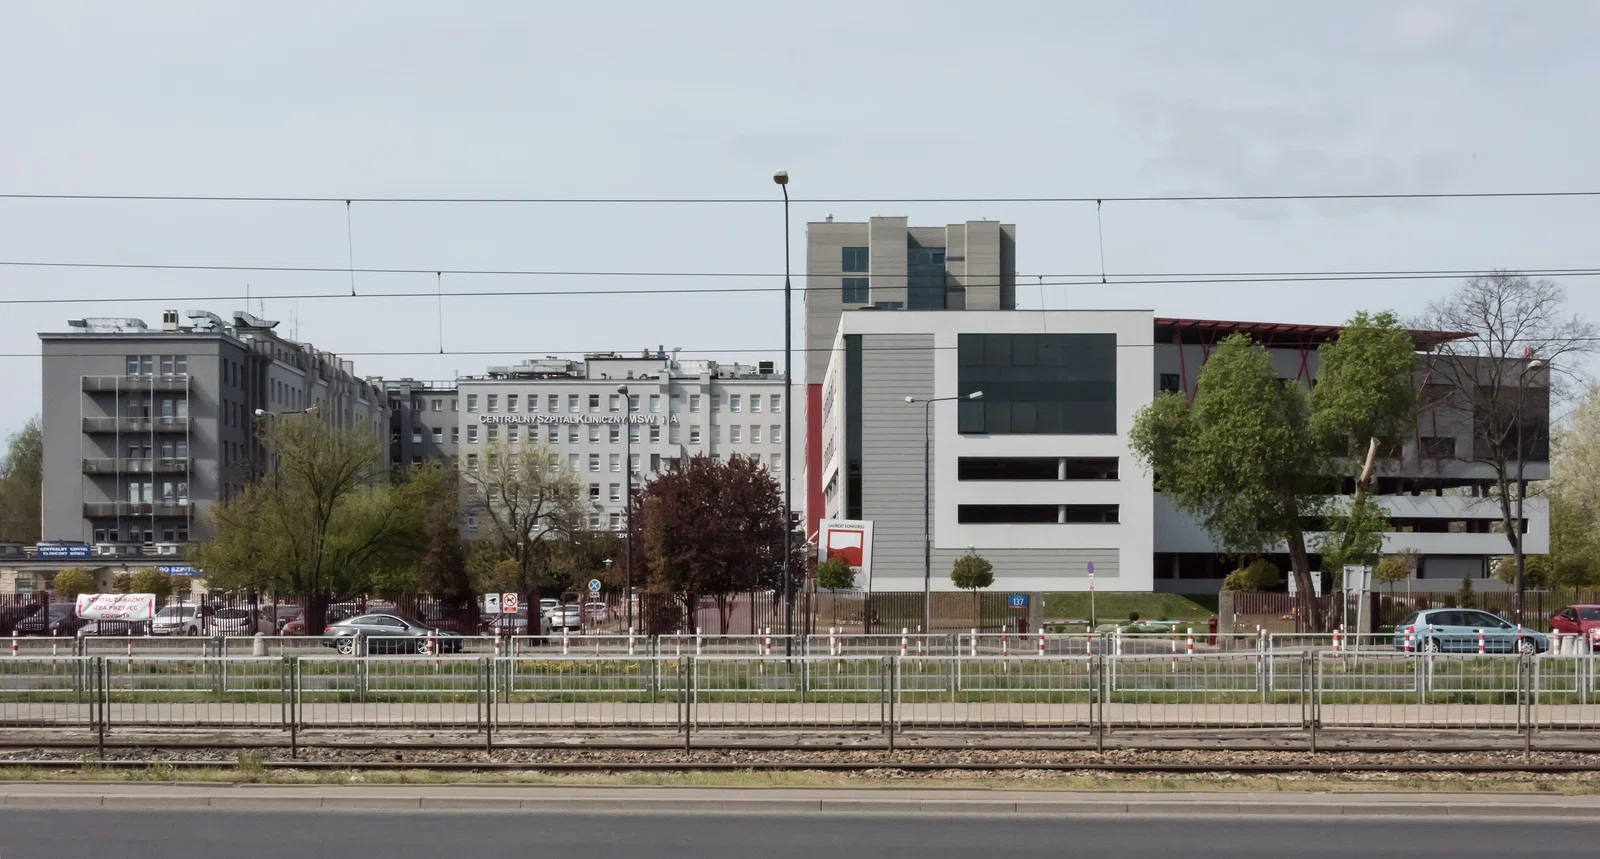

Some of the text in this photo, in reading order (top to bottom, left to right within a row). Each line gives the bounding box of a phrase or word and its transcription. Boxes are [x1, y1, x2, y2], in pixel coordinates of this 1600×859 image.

[479, 414, 537, 424] CENTRALNY
[537, 414, 575, 424] SZPITAL
[577, 414, 626, 424] KLINICZNY
